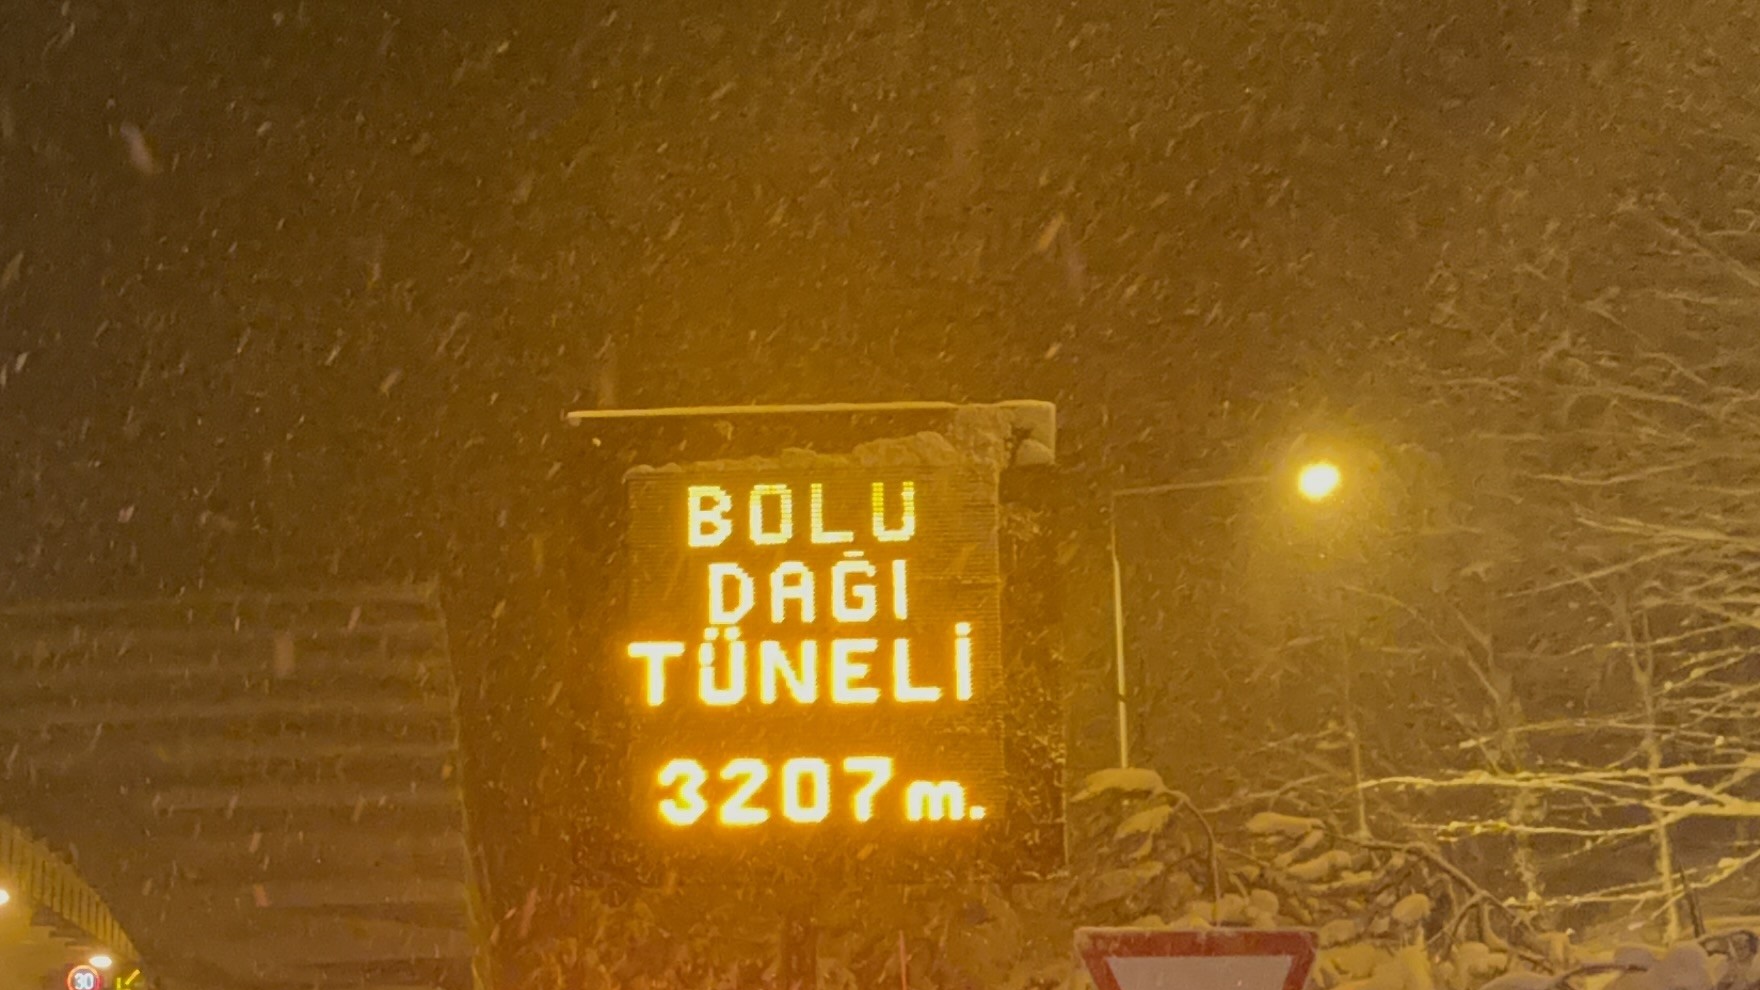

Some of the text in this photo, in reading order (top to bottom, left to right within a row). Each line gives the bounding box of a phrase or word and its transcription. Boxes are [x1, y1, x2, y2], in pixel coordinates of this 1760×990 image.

[687, 481, 916, 548] BOLU
[707, 551, 909, 625] DAĞI
[627, 622, 973, 706] TÜNELİ
[657, 756, 986, 825] 3207 m.
